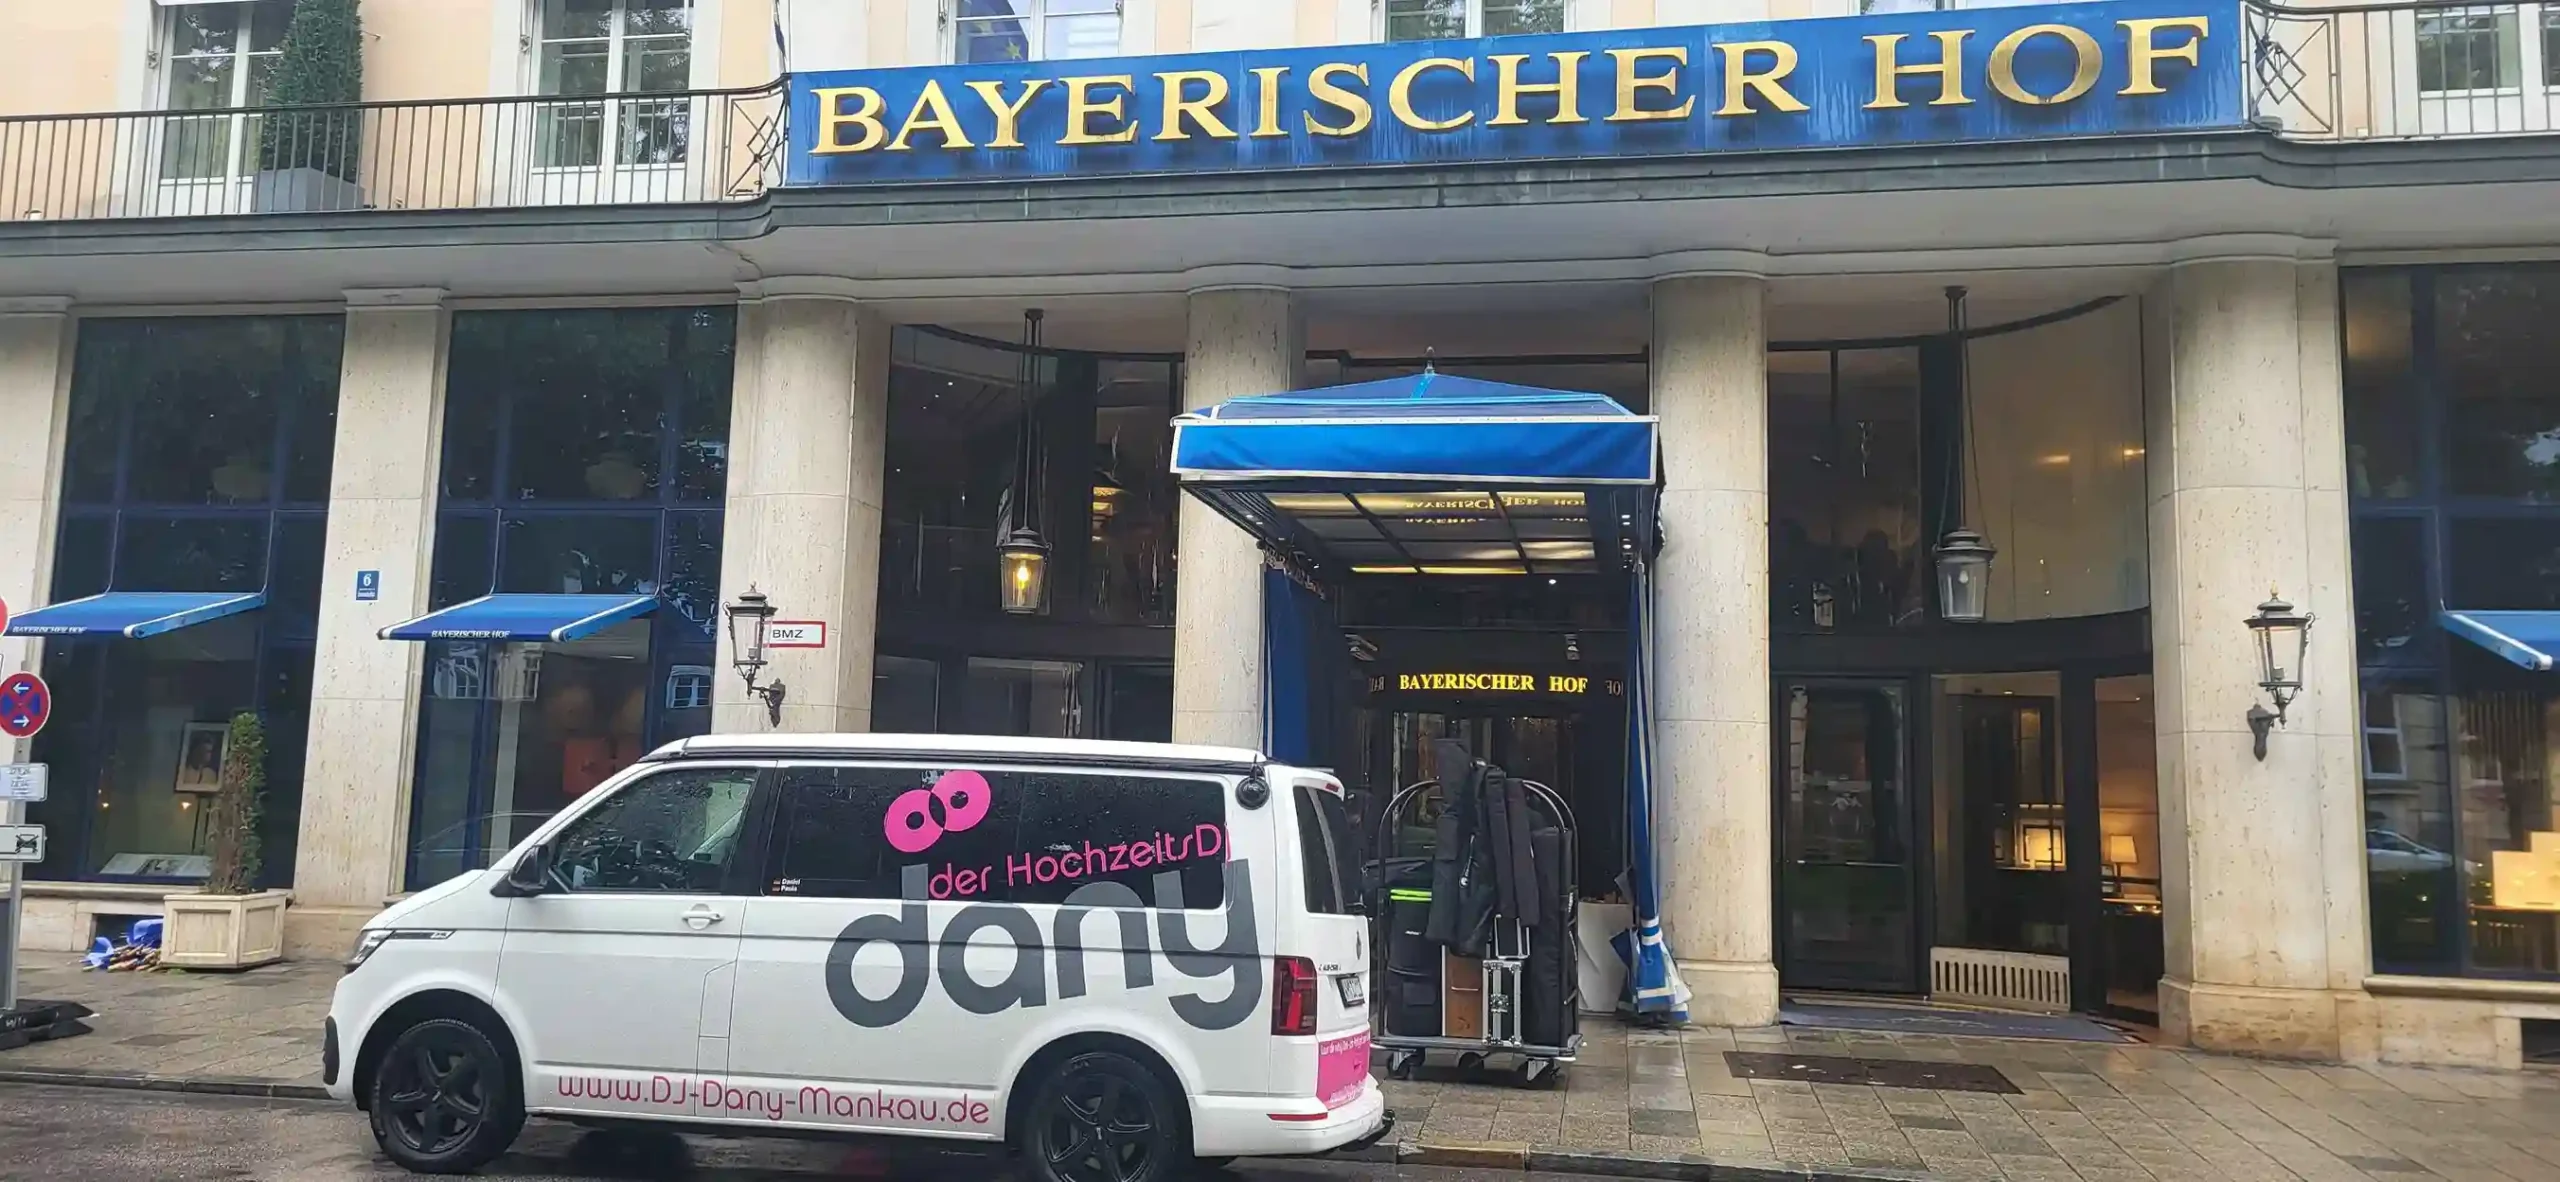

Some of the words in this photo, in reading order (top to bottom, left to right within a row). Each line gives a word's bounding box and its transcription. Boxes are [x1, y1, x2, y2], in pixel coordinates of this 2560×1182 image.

[808, 40, 1811, 156] BAYERISCHER
[1860, 15, 2210, 111] HOF
[363, 573, 372, 587] 6
[772, 629, 804, 639] BMZ
[1400, 673, 1535, 691] BAYERISCHER
[1549, 676, 1588, 693] HOF
[929, 862, 993, 899] der
[825, 858, 1263, 1031] dany
[558, 1075, 990, 1125] www.DJ-Dany-Mankau.de
